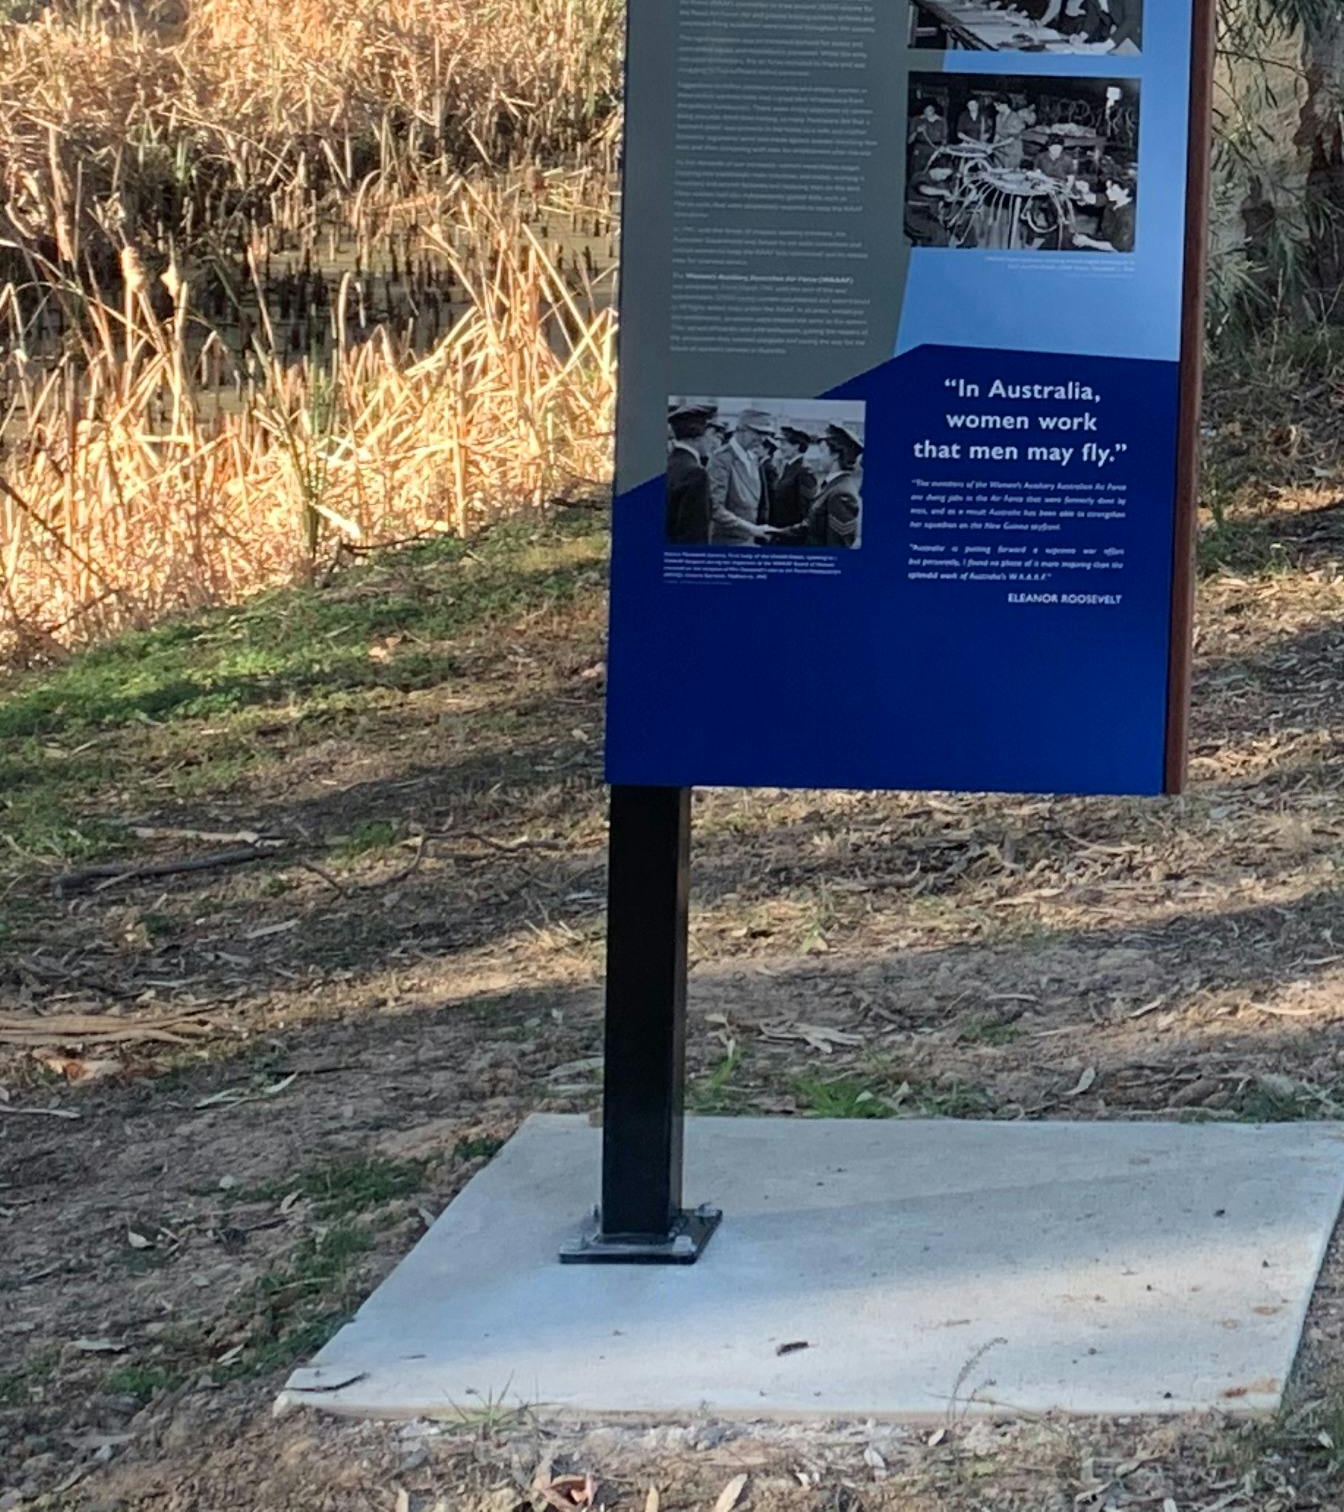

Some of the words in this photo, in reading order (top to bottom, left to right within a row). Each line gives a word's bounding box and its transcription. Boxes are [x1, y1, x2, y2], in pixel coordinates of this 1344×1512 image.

[944, 378, 979, 398] “In
[988, 379, 1101, 403] Australia,
[946, 413, 1029, 430] women
[1039, 412, 1097, 432] work
[913, 440, 961, 459] that
[969, 443, 1018, 460] men
[1027, 445, 1073, 467] may
[1082, 443, 1128, 467] fly.”
[1008, 593, 1058, 604] ELEANOR
[1061, 593, 1122, 605] ROOSEVELT
